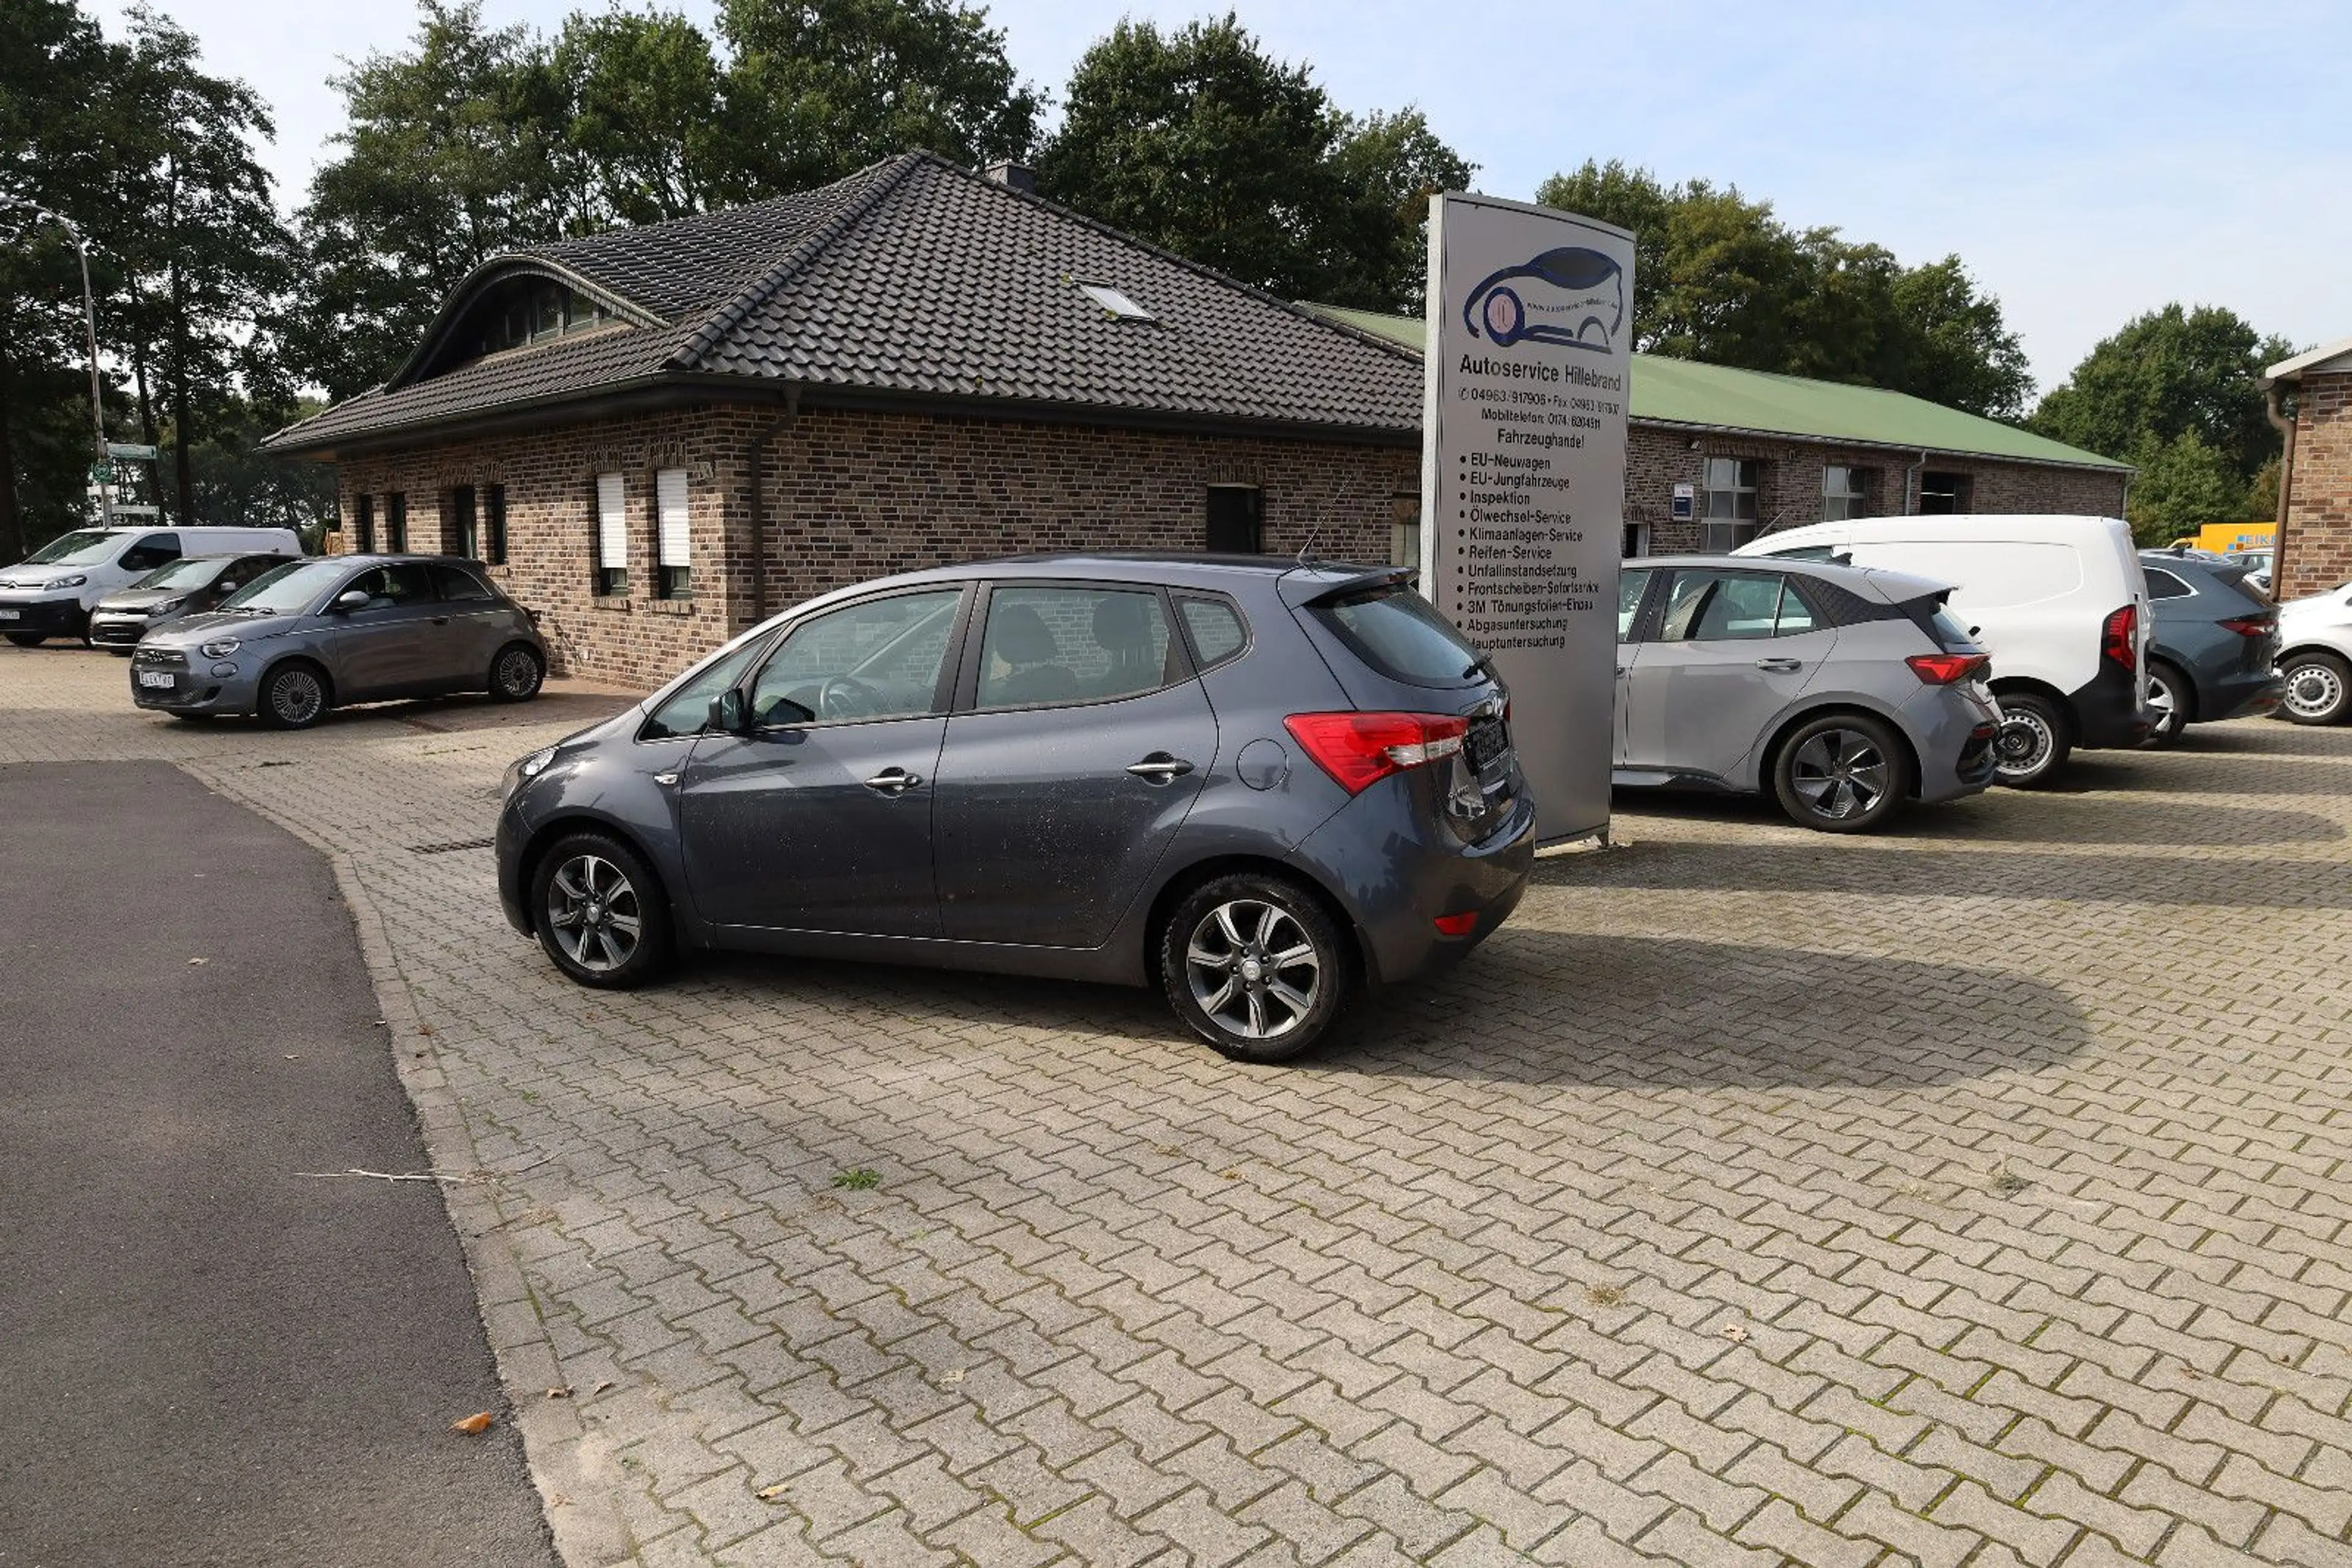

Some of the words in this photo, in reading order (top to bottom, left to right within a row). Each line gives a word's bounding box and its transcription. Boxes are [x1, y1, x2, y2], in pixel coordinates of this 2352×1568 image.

[1460, 354, 1559, 382] Autoservice
[1566, 364, 1621, 392] Hillebrand
[1497, 428, 1585, 449] Fahrzeughandel
[1471, 452, 1551, 472] EU-Neuwagen
[1470, 471, 1570, 491] EU-Jungfahrzeuge
[1469, 489, 1530, 506] Inspektion
[1470, 505, 1572, 524] Ölwechsel-Service
[1469, 527, 1583, 544] Klimaanlagen-Service
[1469, 545, 1552, 560] Reifen-Service
[1468, 564, 1578, 579] Unfallinstandsetzung
[1467, 600, 1486, 614] 3M
[1466, 618, 1568, 635] Abgasuntersuchung
